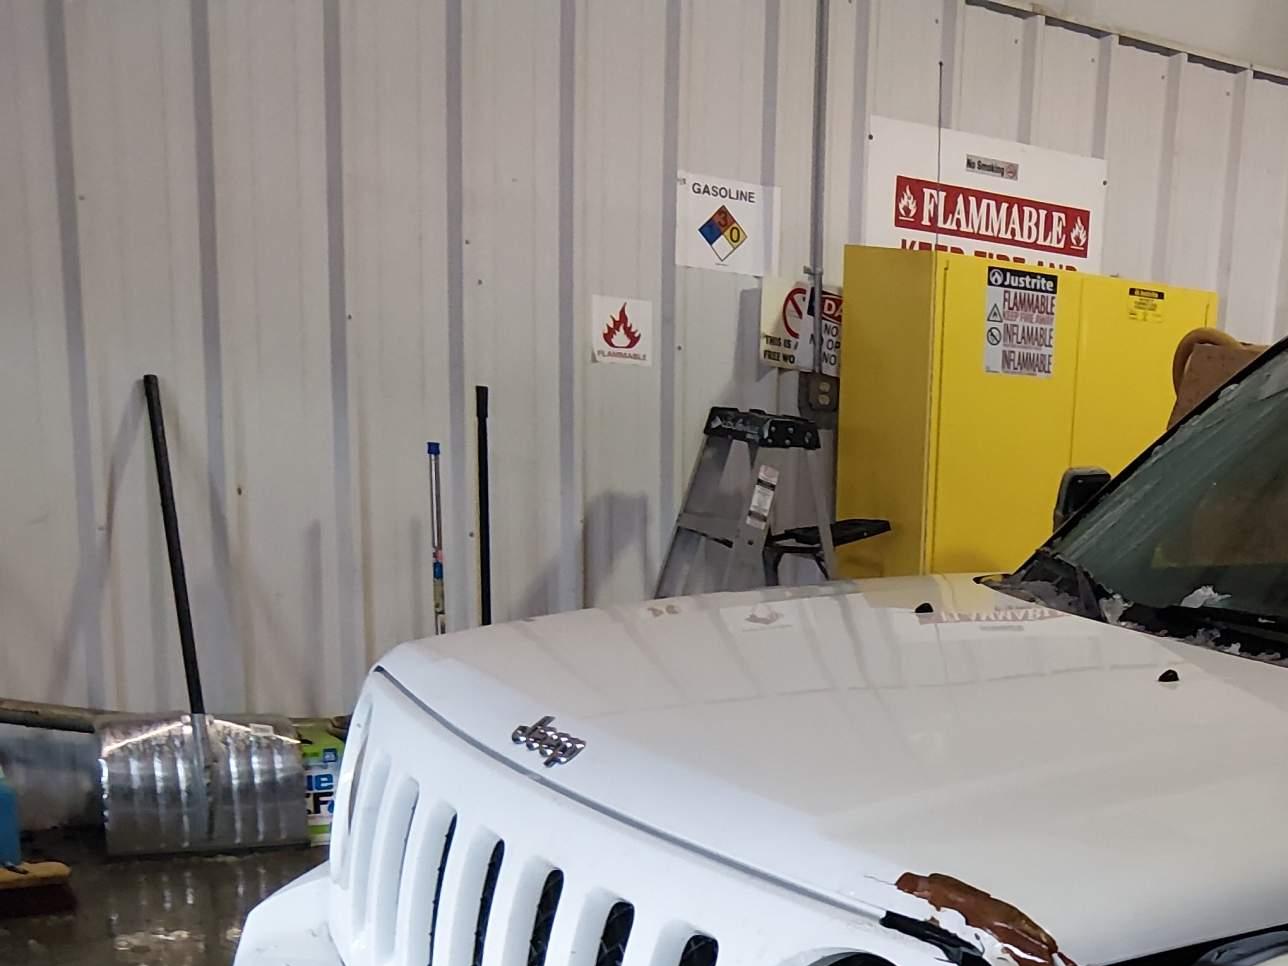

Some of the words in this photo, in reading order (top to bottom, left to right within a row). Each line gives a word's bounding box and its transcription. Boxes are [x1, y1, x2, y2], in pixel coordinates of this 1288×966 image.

[966, 158, 976, 169] No
[977, 160, 1005, 177] Smoking
[691, 182, 756, 203] GASOLINE
[717, 210, 728, 228] 3
[920, 187, 1067, 248] FLAMMABLE
[729, 226, 741, 243] 0
[1003, 271, 1054, 292] Justrite
[1003, 290, 1056, 316] FLAMMABLE
[823, 323, 839, 338] NO
[1002, 323, 1053, 348] INFLAMABLE
[763, 335, 782, 347] THIS
[822, 352, 837, 366] NO
[1001, 350, 1052, 374] INFLAMMABLE
